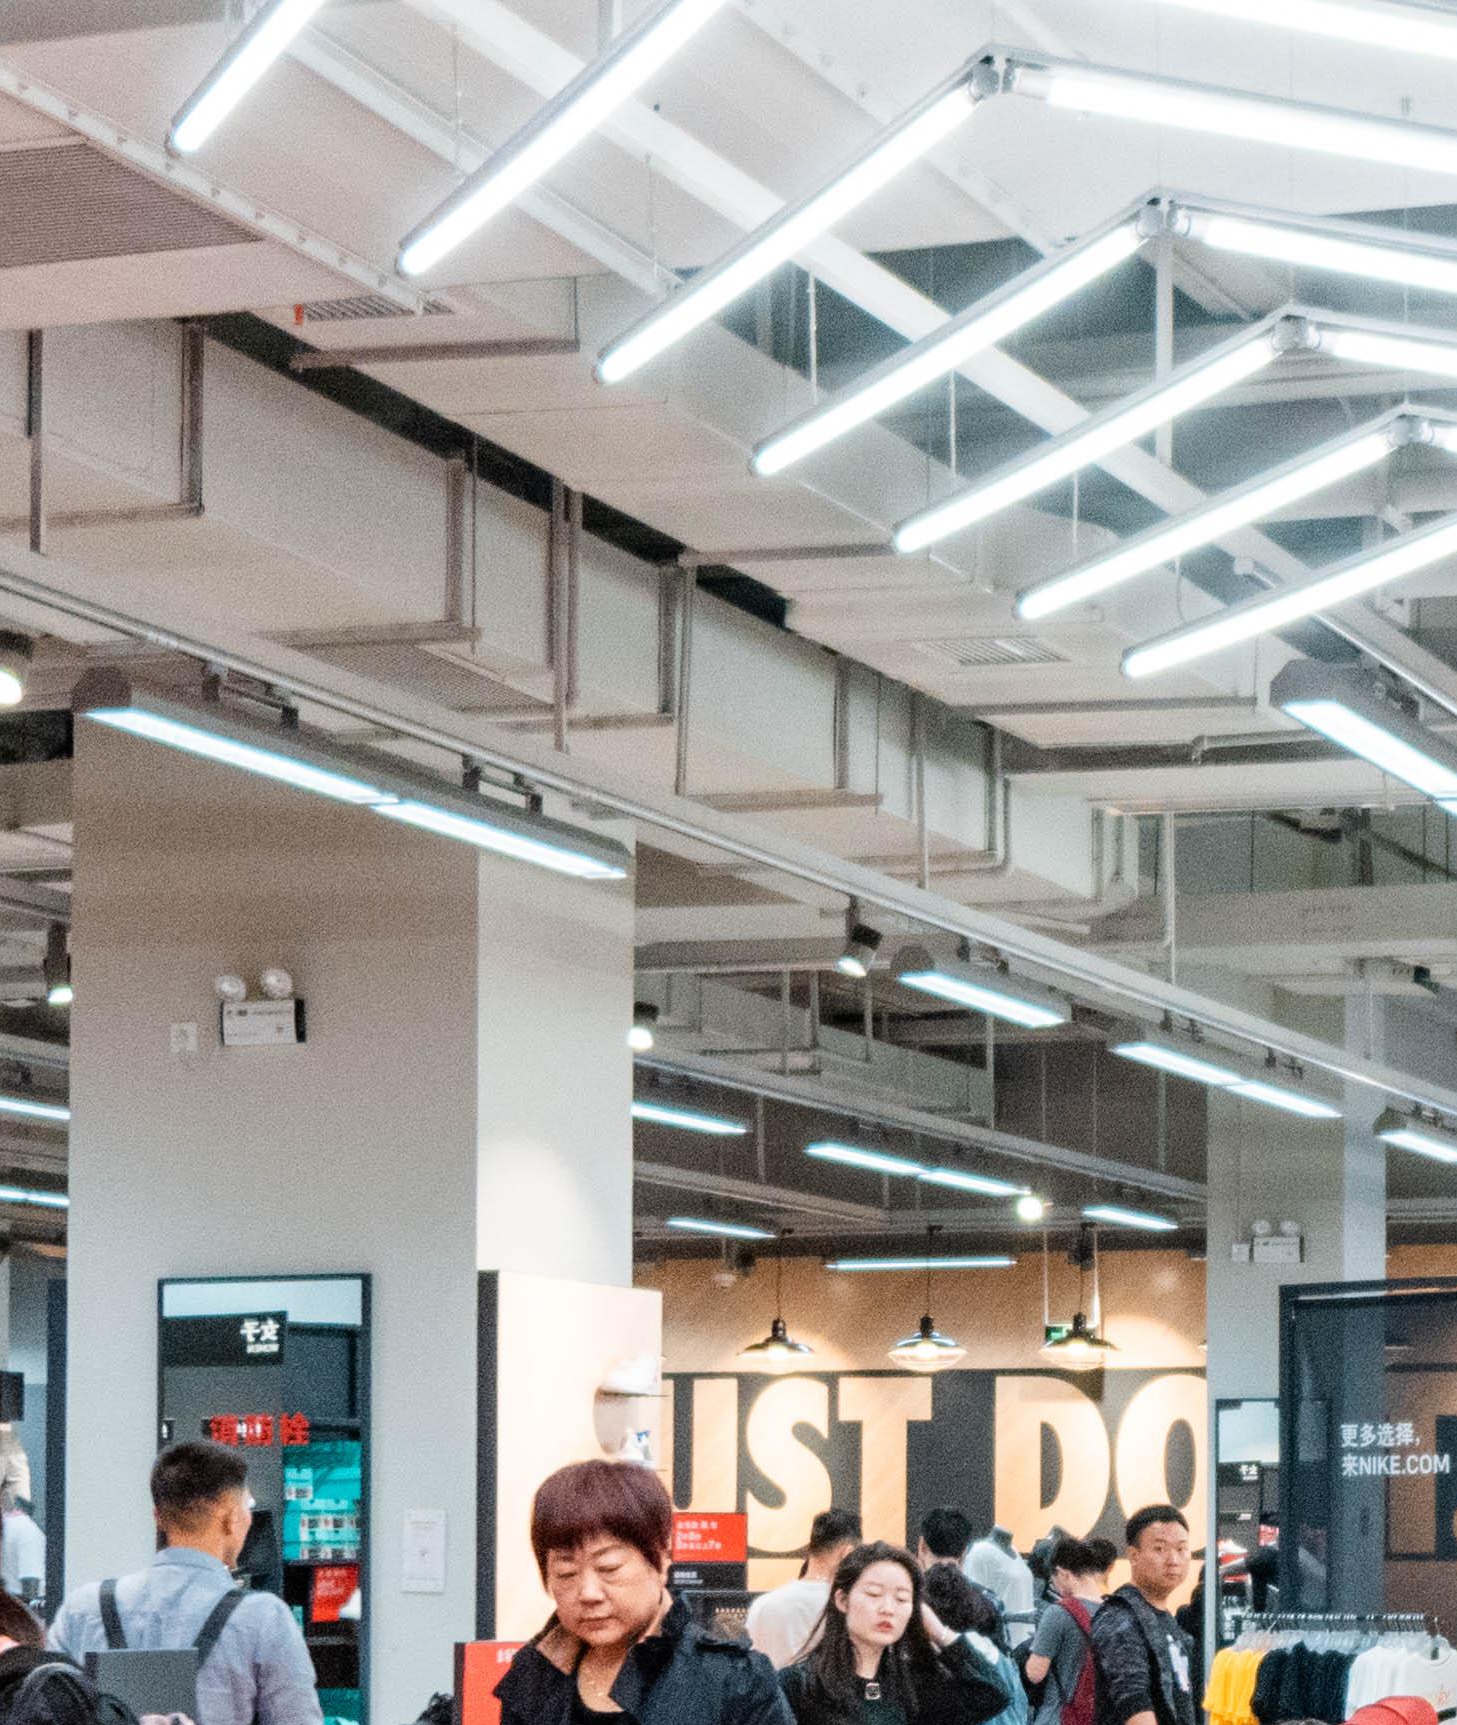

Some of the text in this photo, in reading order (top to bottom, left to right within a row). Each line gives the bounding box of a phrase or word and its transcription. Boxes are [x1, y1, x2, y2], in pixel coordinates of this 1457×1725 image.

[1340, 1422, 1421, 1448] 更多选择，
[662, 1377, 932, 1553] UST
[995, 1375, 1207, 1554] DO
[1342, 1453, 1451, 1477] 来NIKE.COM
